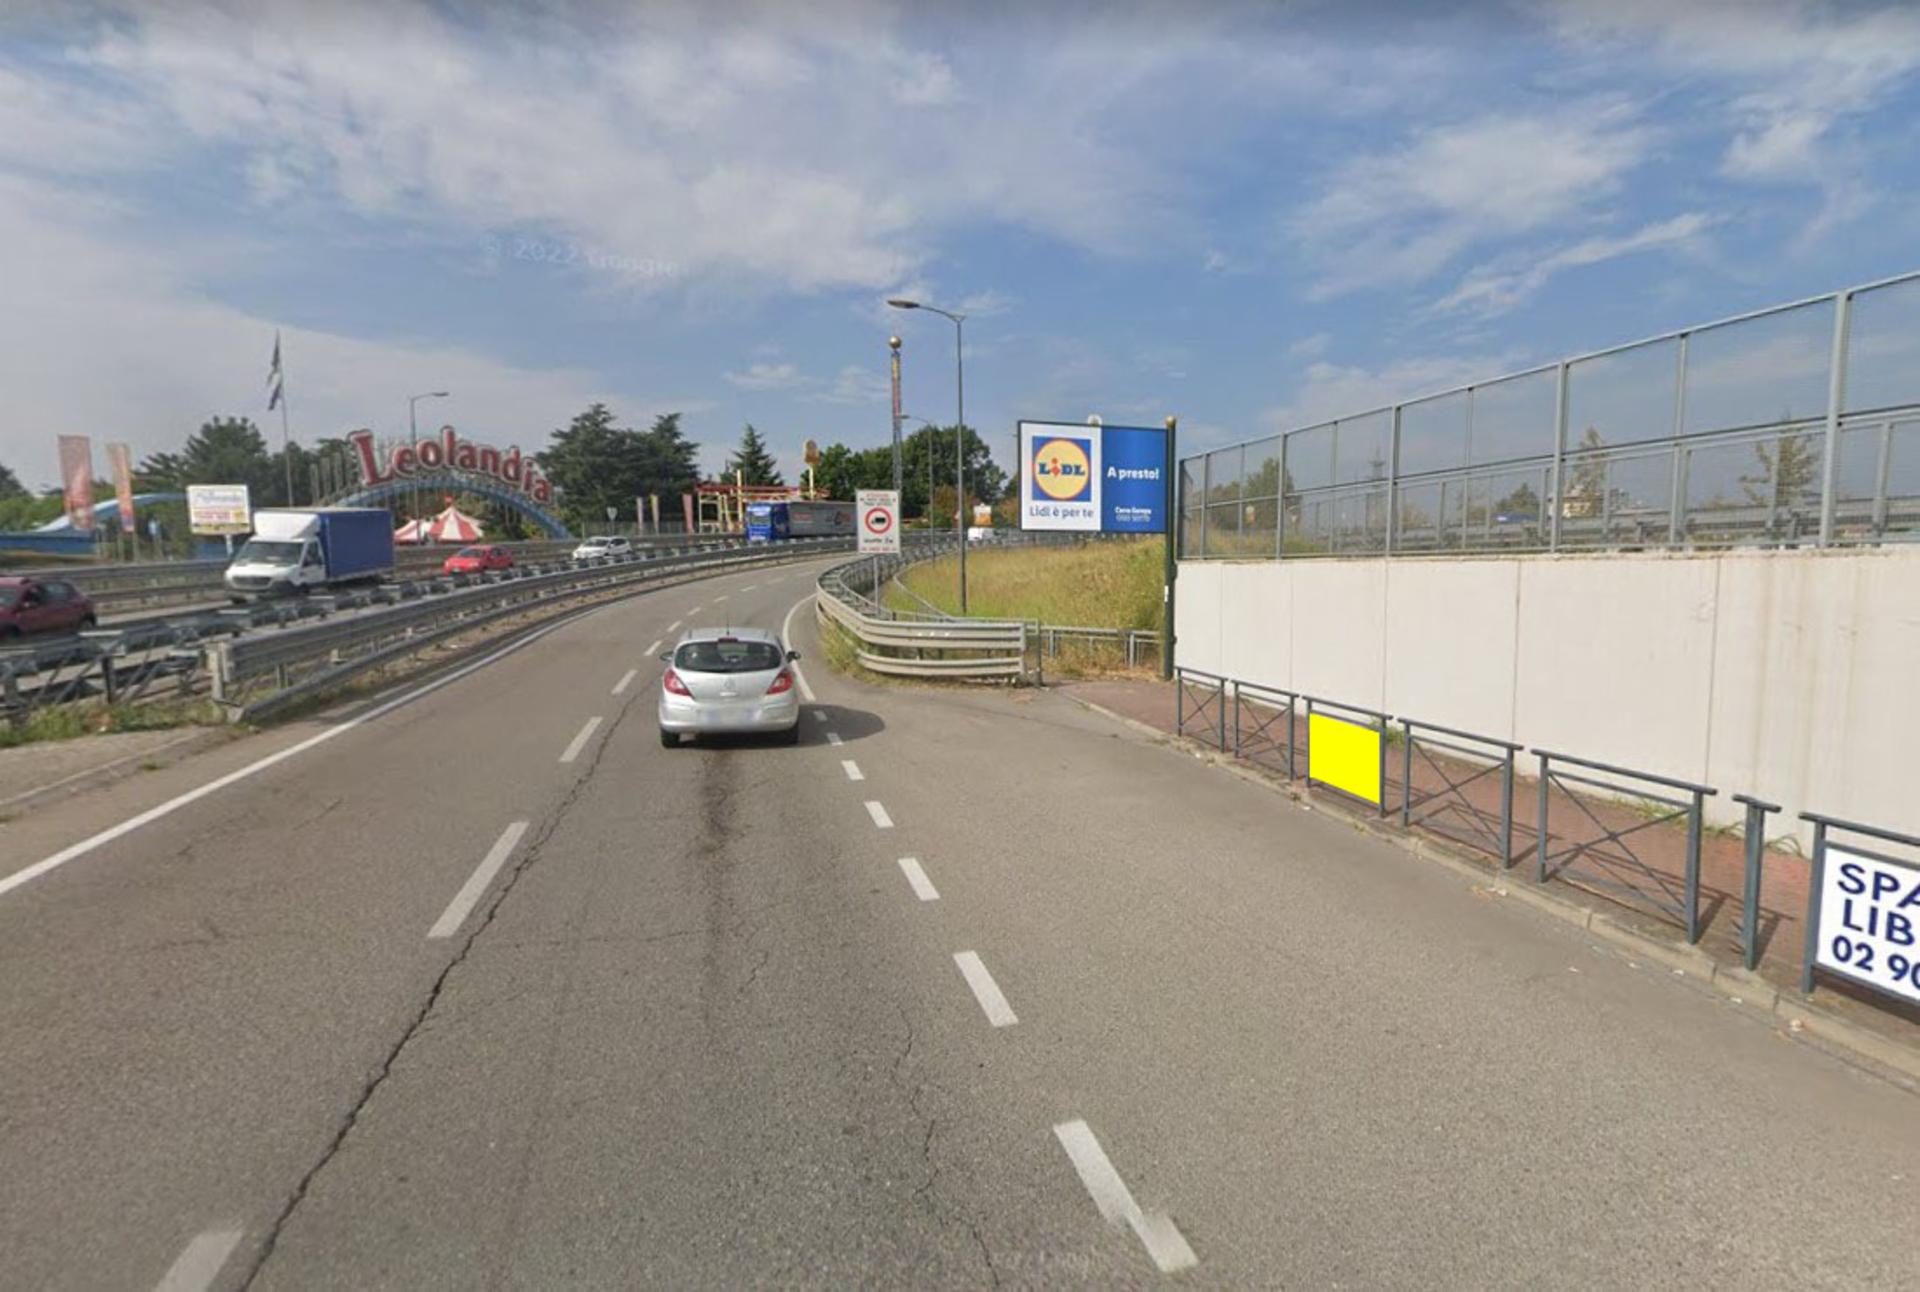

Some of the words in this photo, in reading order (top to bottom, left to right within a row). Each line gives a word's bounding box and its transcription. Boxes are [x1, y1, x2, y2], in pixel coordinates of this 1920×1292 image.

[349, 426, 552, 504] Leolandia
[1107, 466, 1117, 478] A
[1118, 467, 1160, 481] presto!
[1029, 505, 1050, 518] Lidl
[1052, 505, 1060, 518] è
[1061, 507, 1081, 520] per
[1083, 507, 1095, 518] te
[1832, 935, 1874, 972] 02
